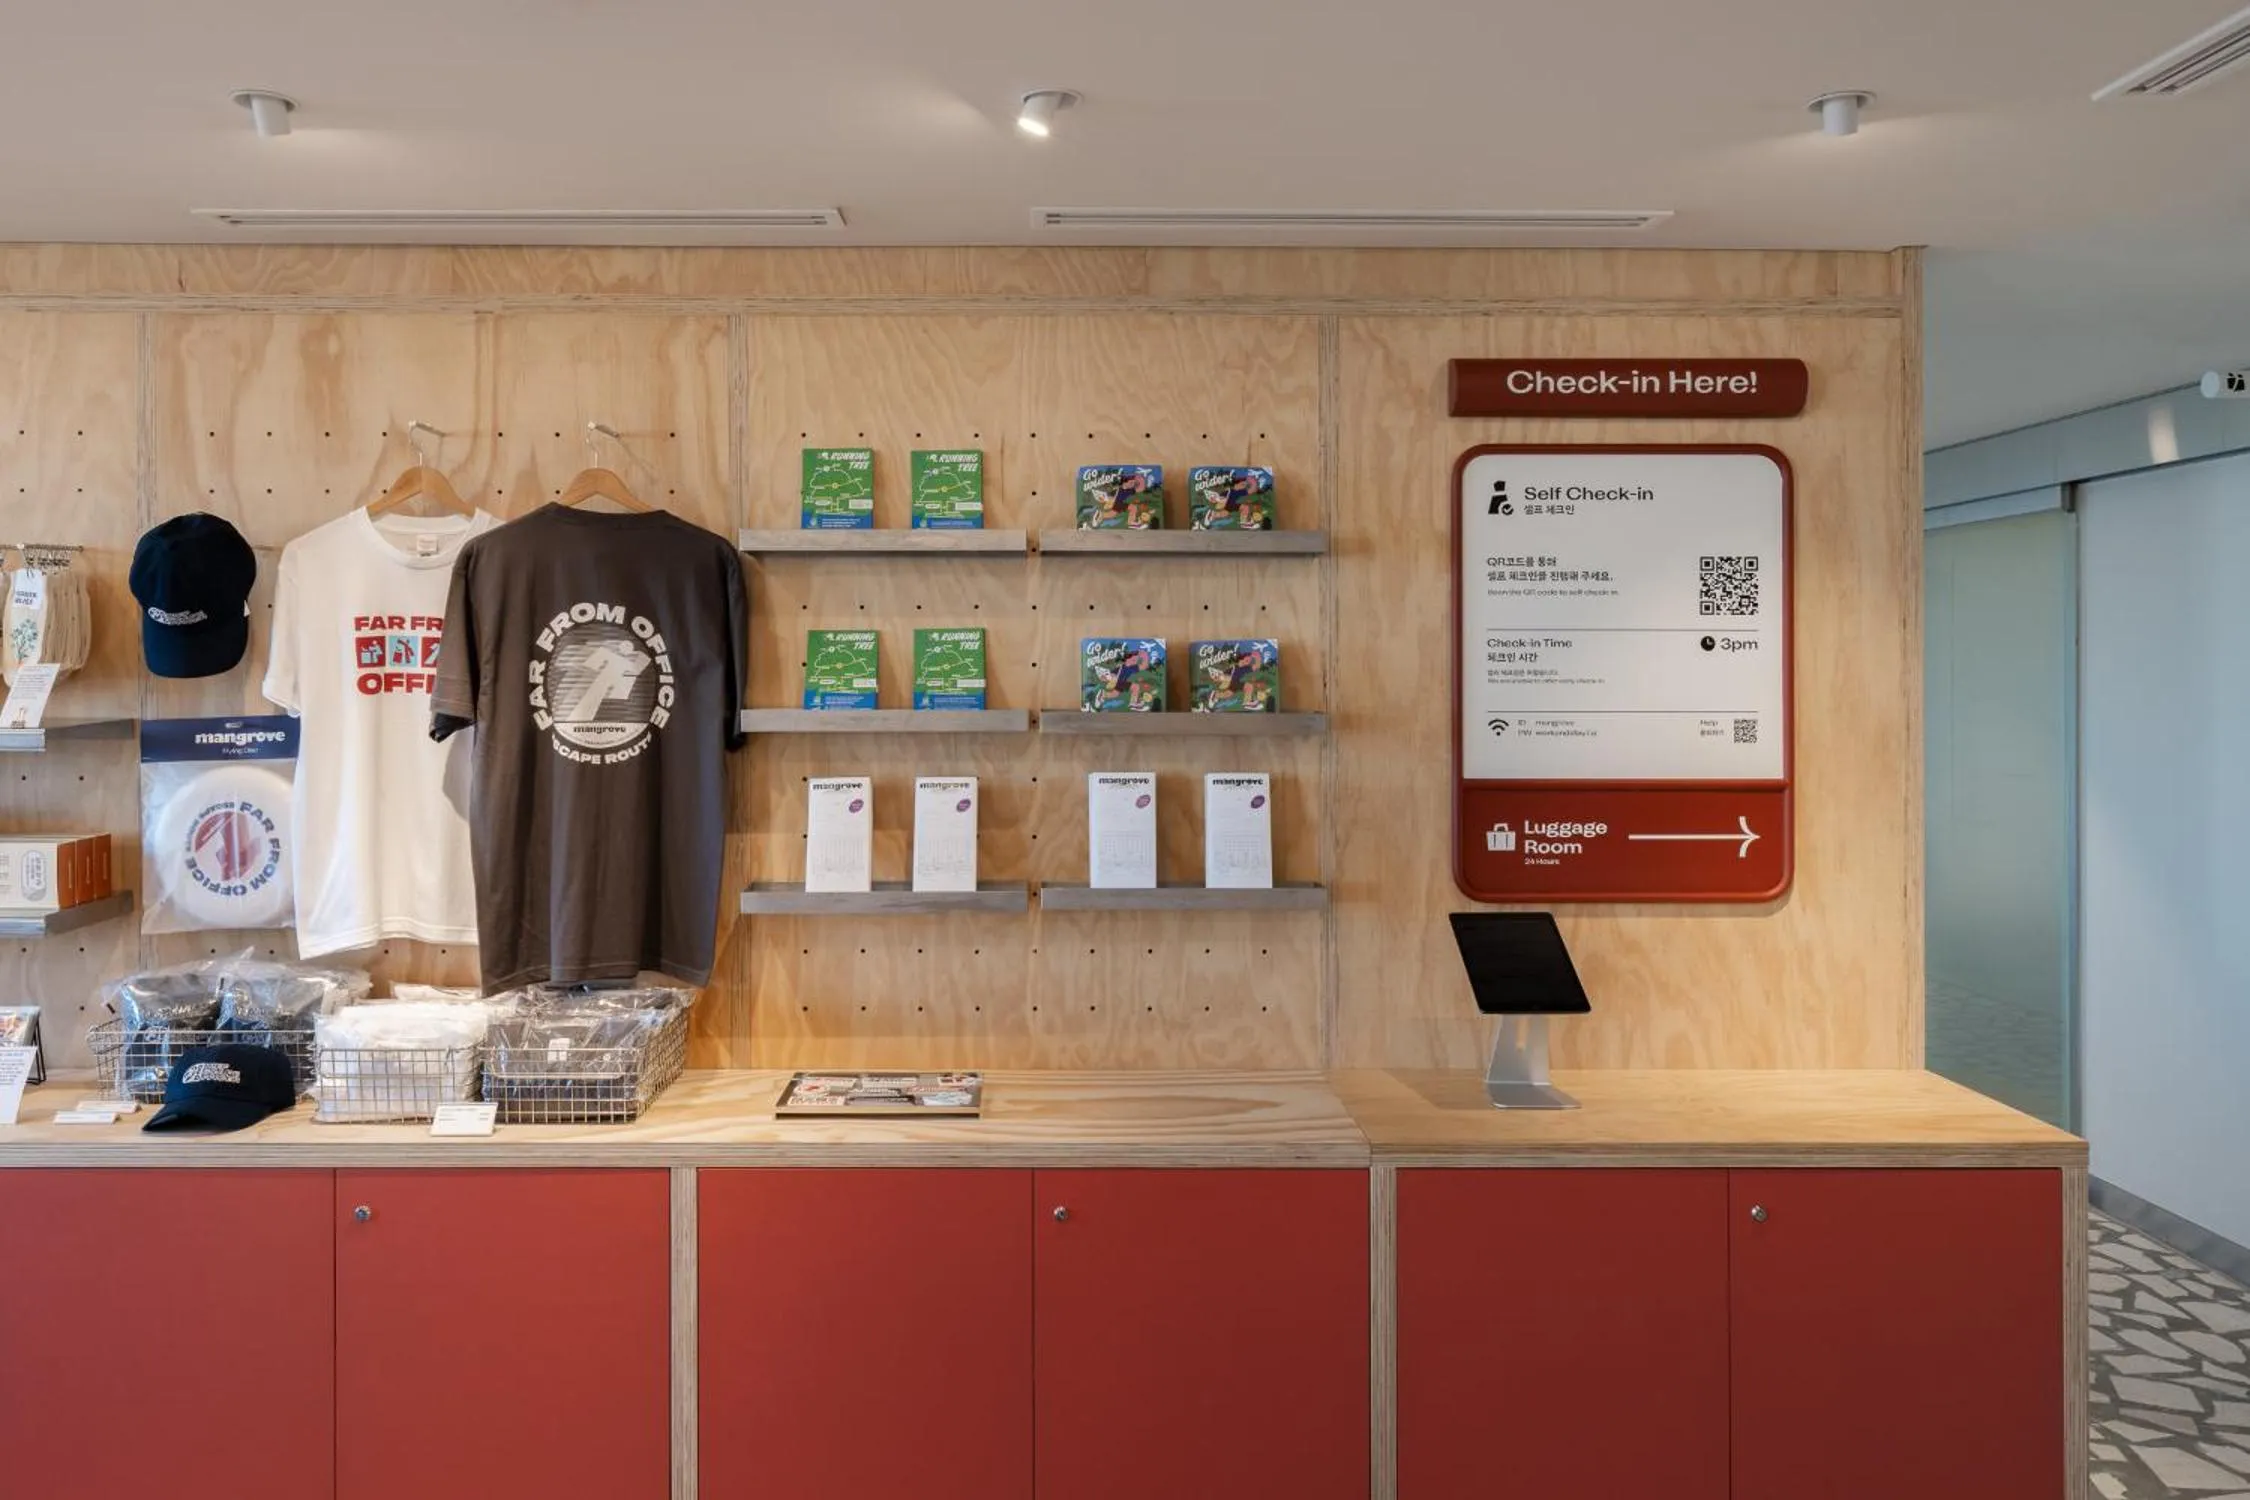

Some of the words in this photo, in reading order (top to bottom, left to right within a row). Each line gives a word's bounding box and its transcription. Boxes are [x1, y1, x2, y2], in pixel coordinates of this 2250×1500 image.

[1506, 370, 1660, 394] Check-in
[1668, 370, 1758, 394] Here!
[1524, 486, 1562, 501] Self
[1566, 486, 1654, 501] Check-in
[1487, 557, 1534, 567] QR코드를
[355, 616, 405, 631] FAR
[411, 616, 443, 631] FR
[536, 602, 626, 653] FROM
[1487, 638, 1541, 648] Check-in
[1543, 638, 1573, 648] Time
[1721, 637, 1758, 652] 3pm
[1487, 652, 1515, 662] 체크인
[1519, 652, 1538, 662] 시간
[631, 616, 674, 730] OFFICE
[357, 673, 435, 695] OFFI
[529, 659, 553, 731] FAR
[573, 725, 626, 735] mangrove
[195, 731, 286, 746] mangrove
[812, 782, 863, 791] mangrove
[1099, 777, 1149, 786] mangrove
[1213, 778, 1264, 786] mangrove
[239, 801, 275, 832] FAR
[1524, 820, 1607, 838] Luggage
[1524, 841, 1583, 854] Room
[250, 838, 281, 890] FROM
[185, 856, 247, 896] OFFICE
